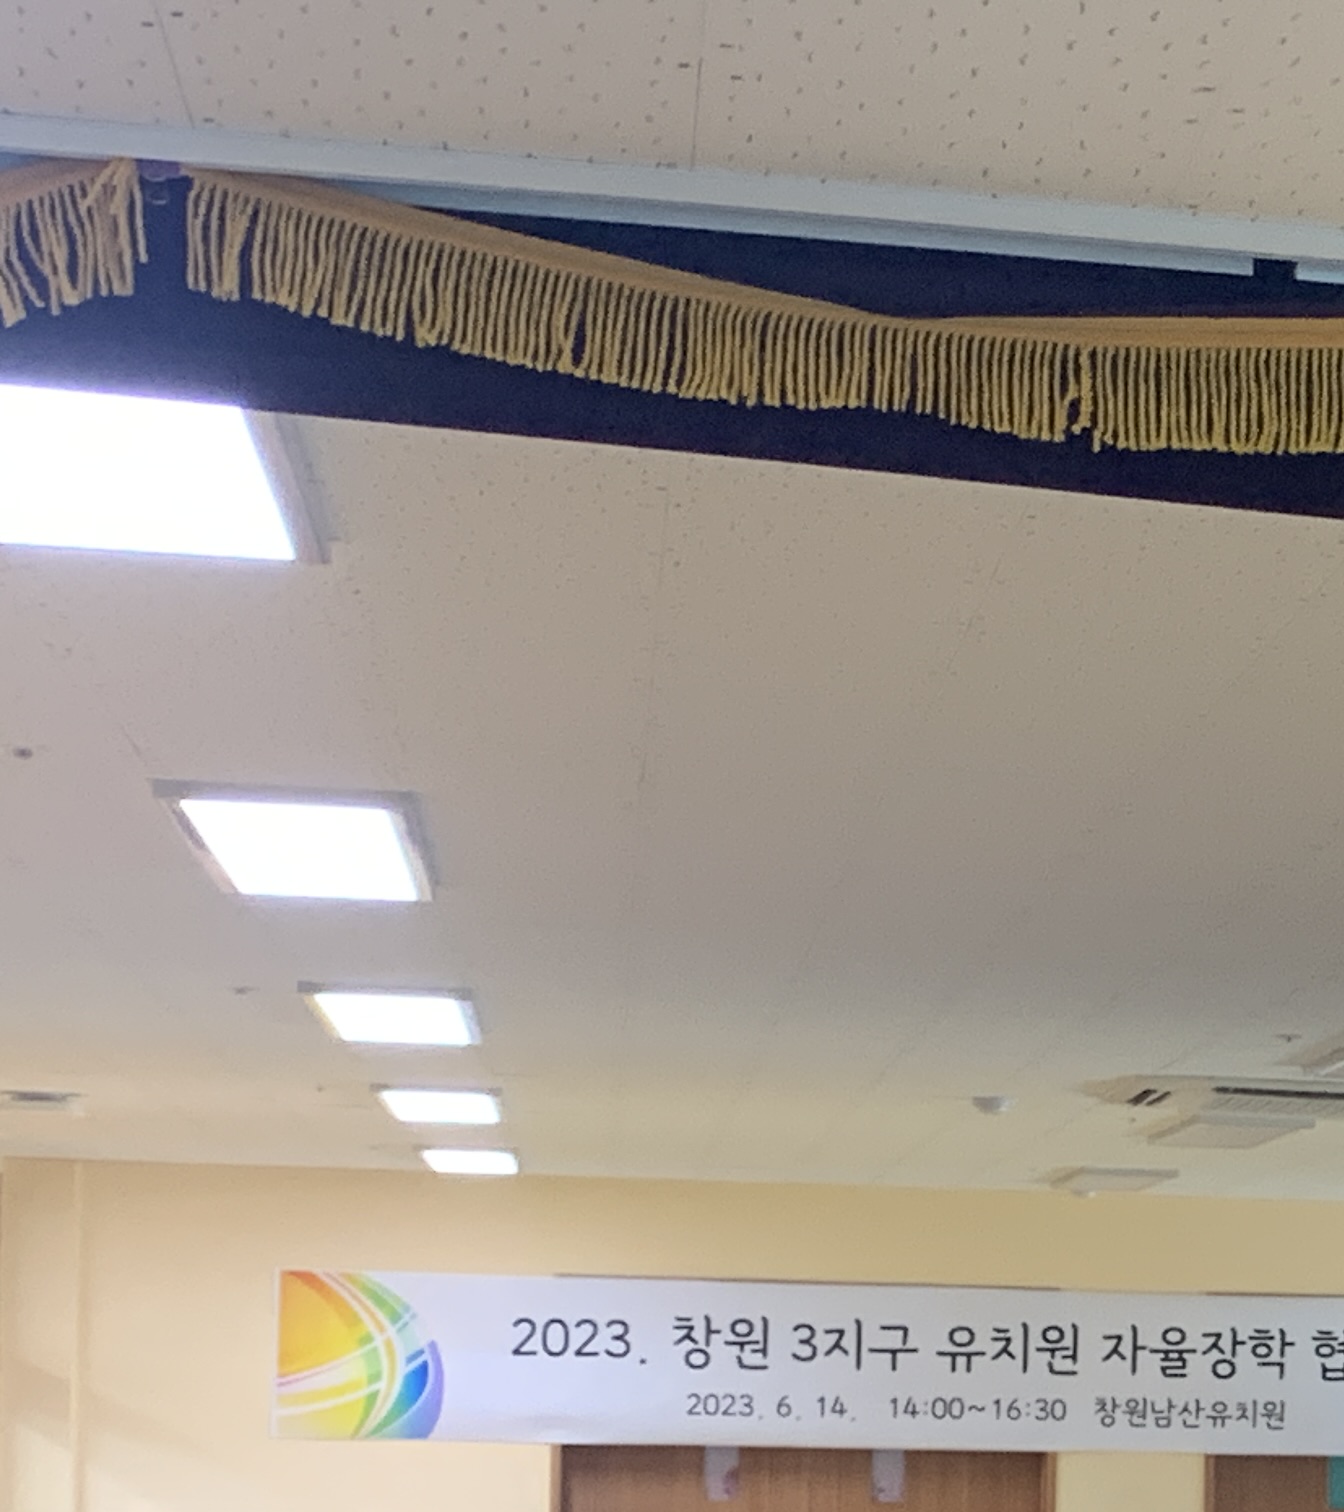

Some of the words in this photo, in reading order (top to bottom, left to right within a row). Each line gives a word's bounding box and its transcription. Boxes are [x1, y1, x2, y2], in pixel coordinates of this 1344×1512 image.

[510, 1316, 648, 1366] 2023.
[671, 1313, 770, 1372] 창원
[790, 1317, 920, 1373] 3지구
[935, 1321, 1080, 1377] 유치원
[1101, 1323, 1297, 1382] 자율장학
[685, 1392, 765, 1421] 2023.
[775, 1394, 801, 1422] 6.
[816, 1395, 857, 1422] 14.
[889, 1396, 1067, 1422] 14:00~16:30
[1094, 1395, 1286, 1431] 창원남산유치원
